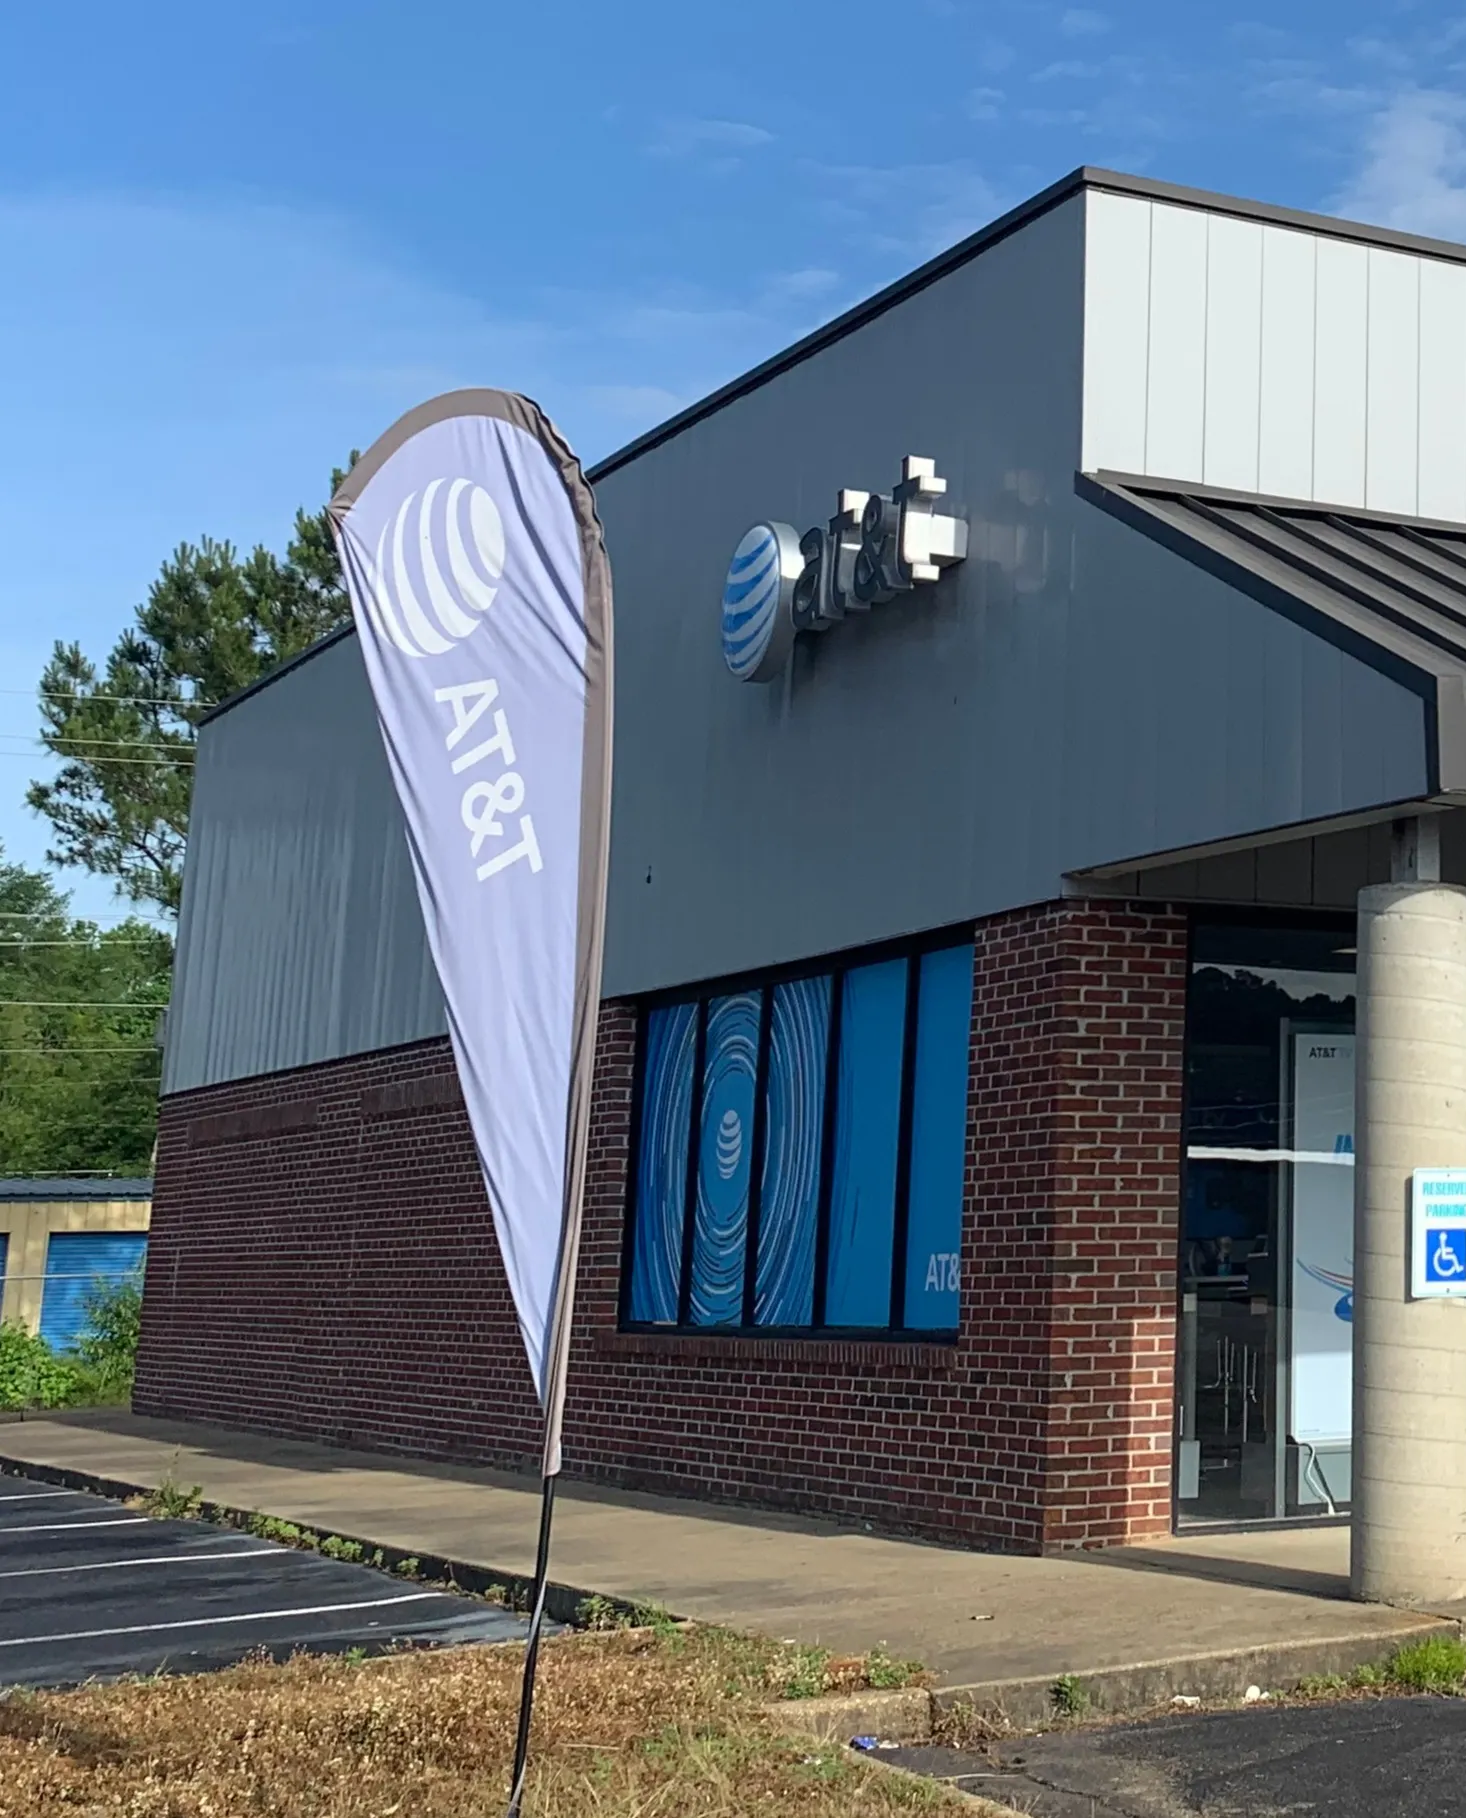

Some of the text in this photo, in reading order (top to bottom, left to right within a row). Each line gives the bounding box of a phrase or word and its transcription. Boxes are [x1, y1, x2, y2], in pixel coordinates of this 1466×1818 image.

[791, 455, 969, 631] at&t
[434, 678, 543, 882] AT&T
[1309, 1047, 1336, 1058] AT&T
[925, 1253, 960, 1292] AT&
